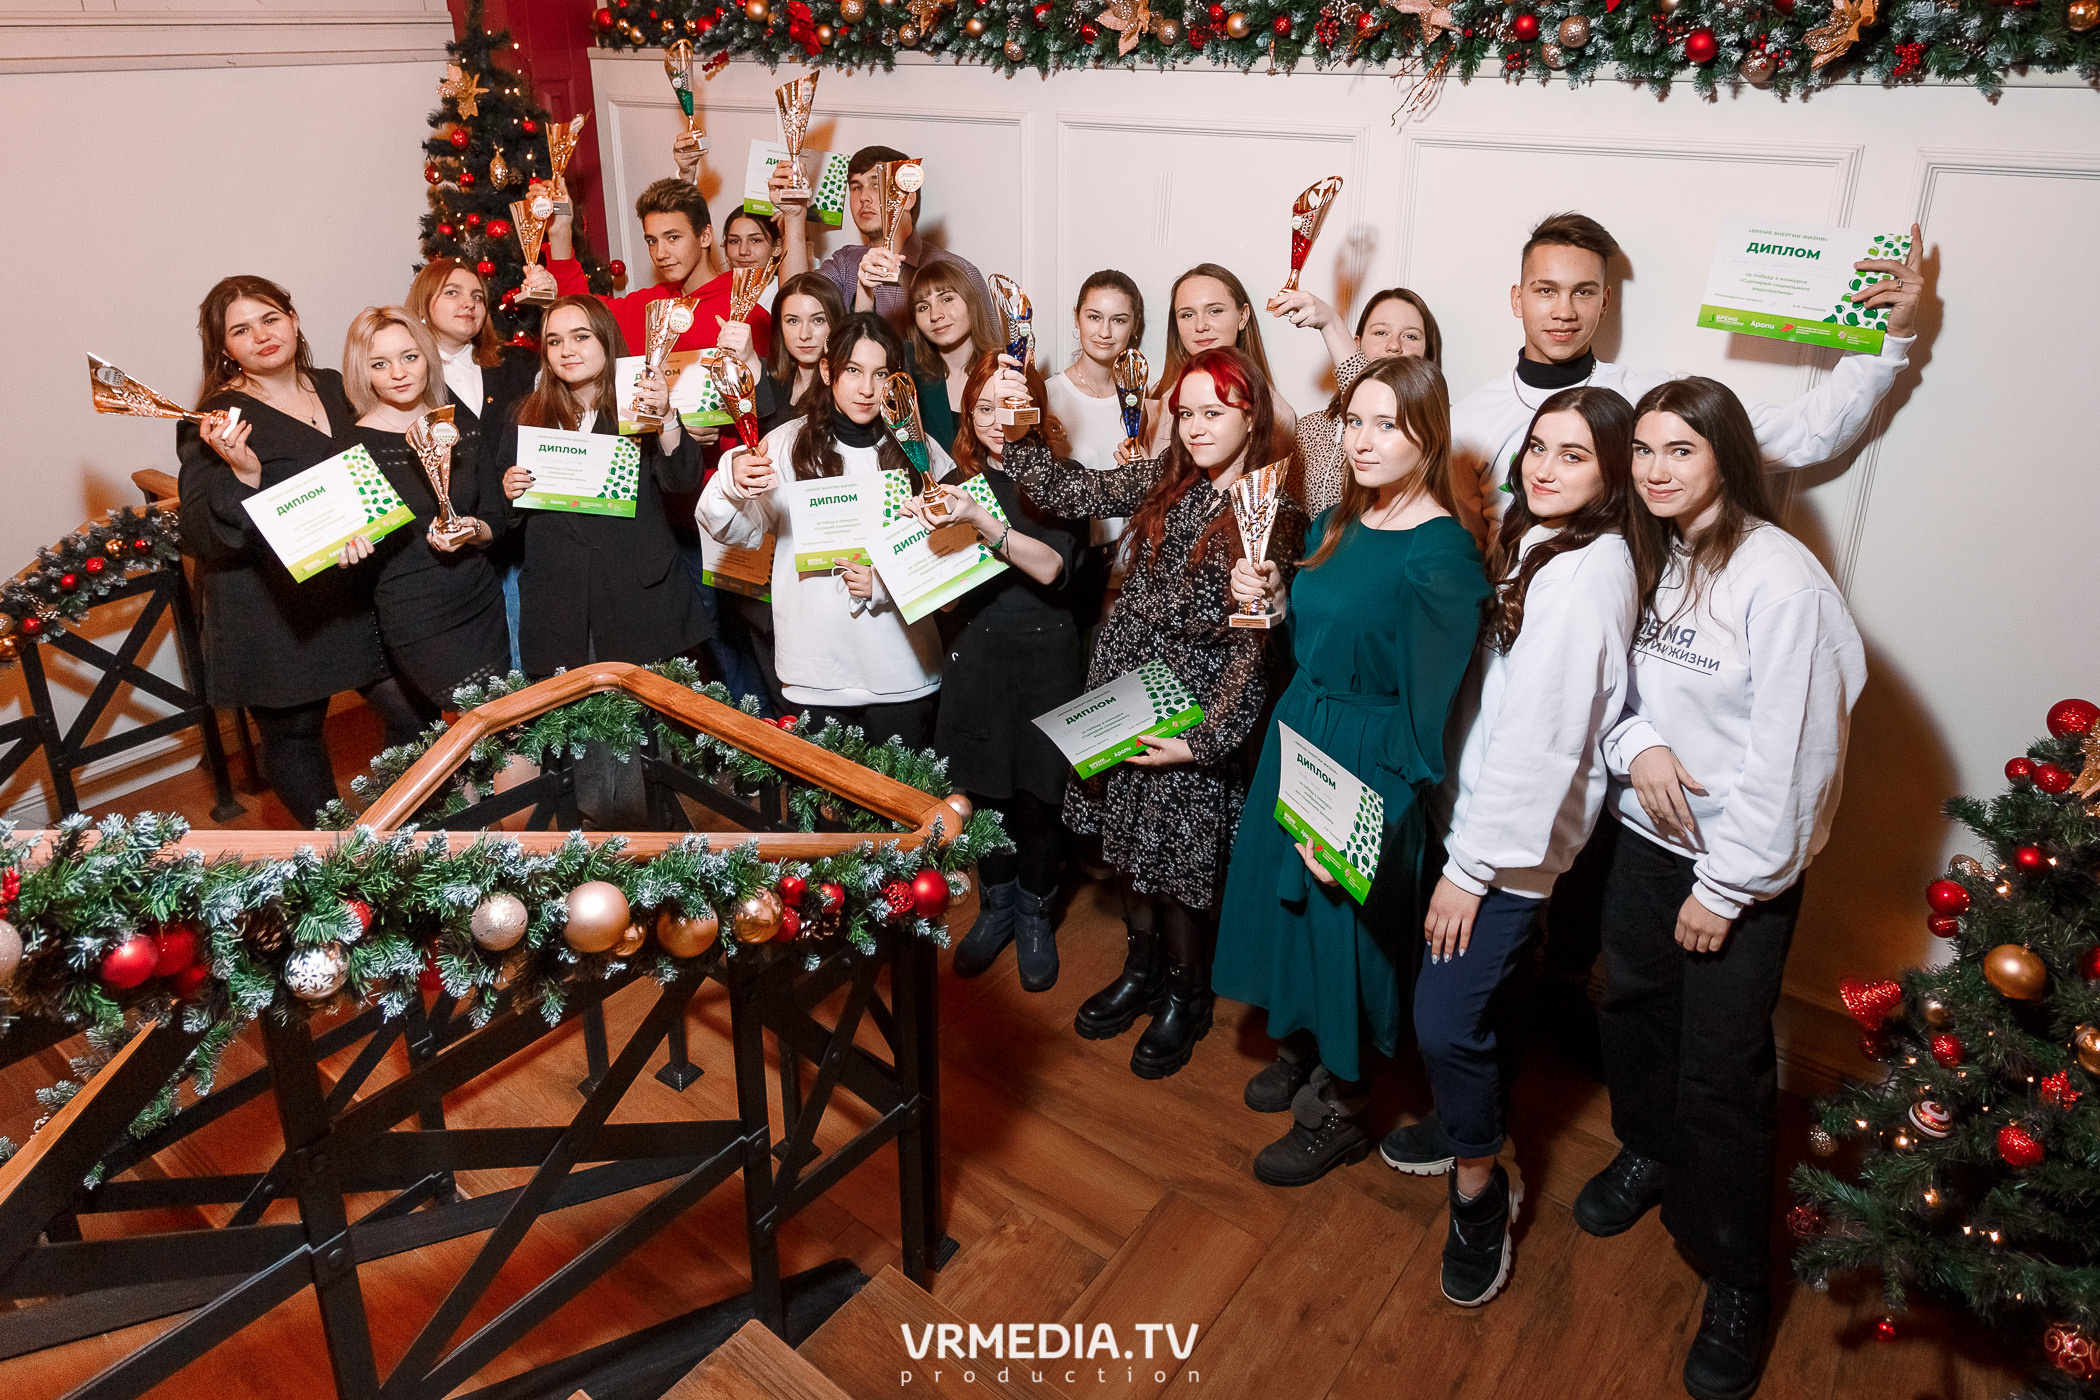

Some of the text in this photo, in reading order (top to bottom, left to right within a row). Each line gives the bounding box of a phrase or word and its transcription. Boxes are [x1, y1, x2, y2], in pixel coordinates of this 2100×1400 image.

[1746, 242, 1821, 260] ДИПЛОМ
[538, 444, 587, 455] ДИПЛОМ
[276, 486, 326, 516] ДИПЛОМ
[810, 494, 858, 507] ДИПЛОМ
[1065, 696, 1116, 725] ДИПЛОМ
[1297, 753, 1336, 790] ДИПЛОМ
